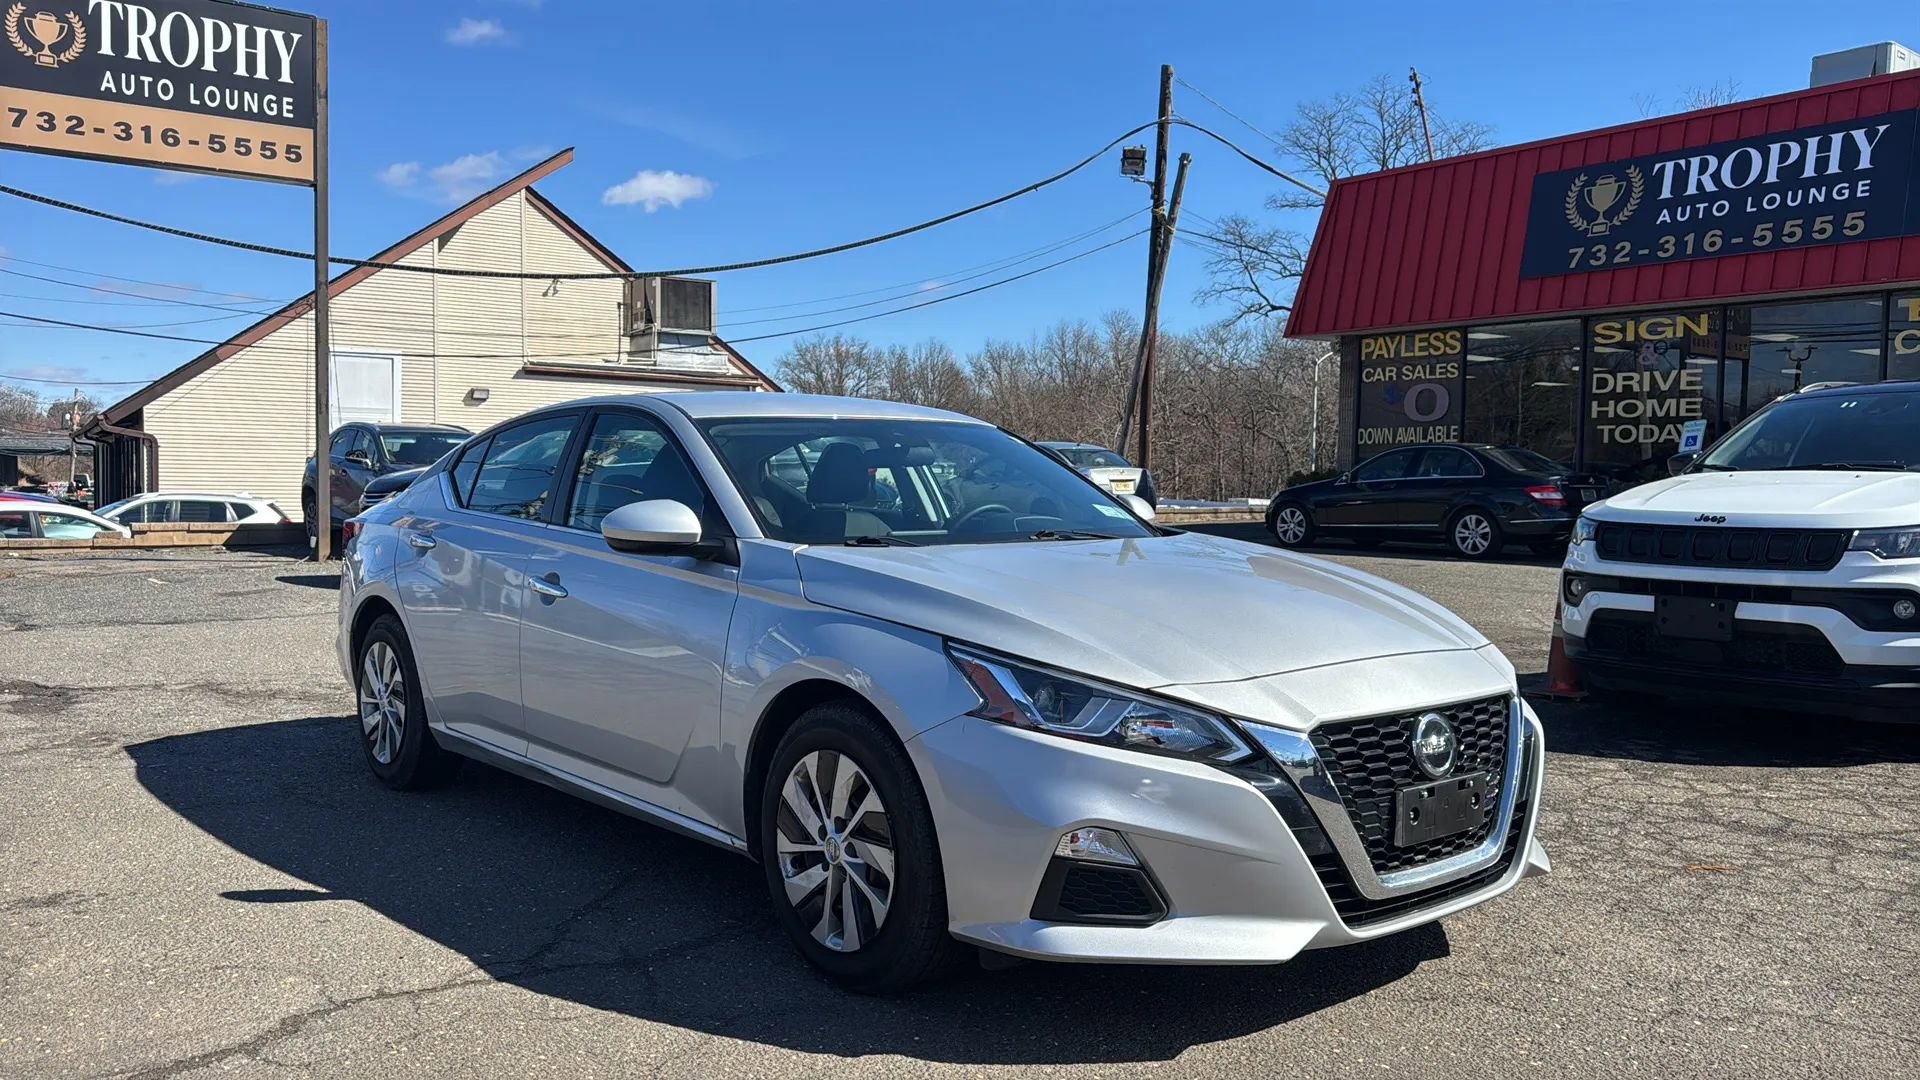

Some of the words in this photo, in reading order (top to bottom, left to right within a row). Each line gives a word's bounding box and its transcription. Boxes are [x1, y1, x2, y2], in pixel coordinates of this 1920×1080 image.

[88, 0, 303, 84] TROPHY
[101, 70, 175, 101] AUTO
[189, 82, 295, 119] LOUNGE
[7, 106, 303, 164] 732-316-5555
[1652, 123, 1891, 200] TROPHY
[1656, 200, 1730, 225] AUTO
[1746, 180, 1872, 213] LOUNGE
[1567, 211, 1867, 270] 732-316-5555
[1593, 313, 1709, 344] SIGN
[1361, 330, 1462, 361] PAYLESS
[1362, 366, 1397, 383] CAR
[1401, 362, 1459, 380] SALES
[1591, 368, 1704, 394] DRIVE
[1591, 397, 1703, 418] HOME
[1358, 426, 1393, 445] DOWN
[1396, 425, 1459, 444] AVAILABLE
[1694, 513, 1727, 525] Jeep
